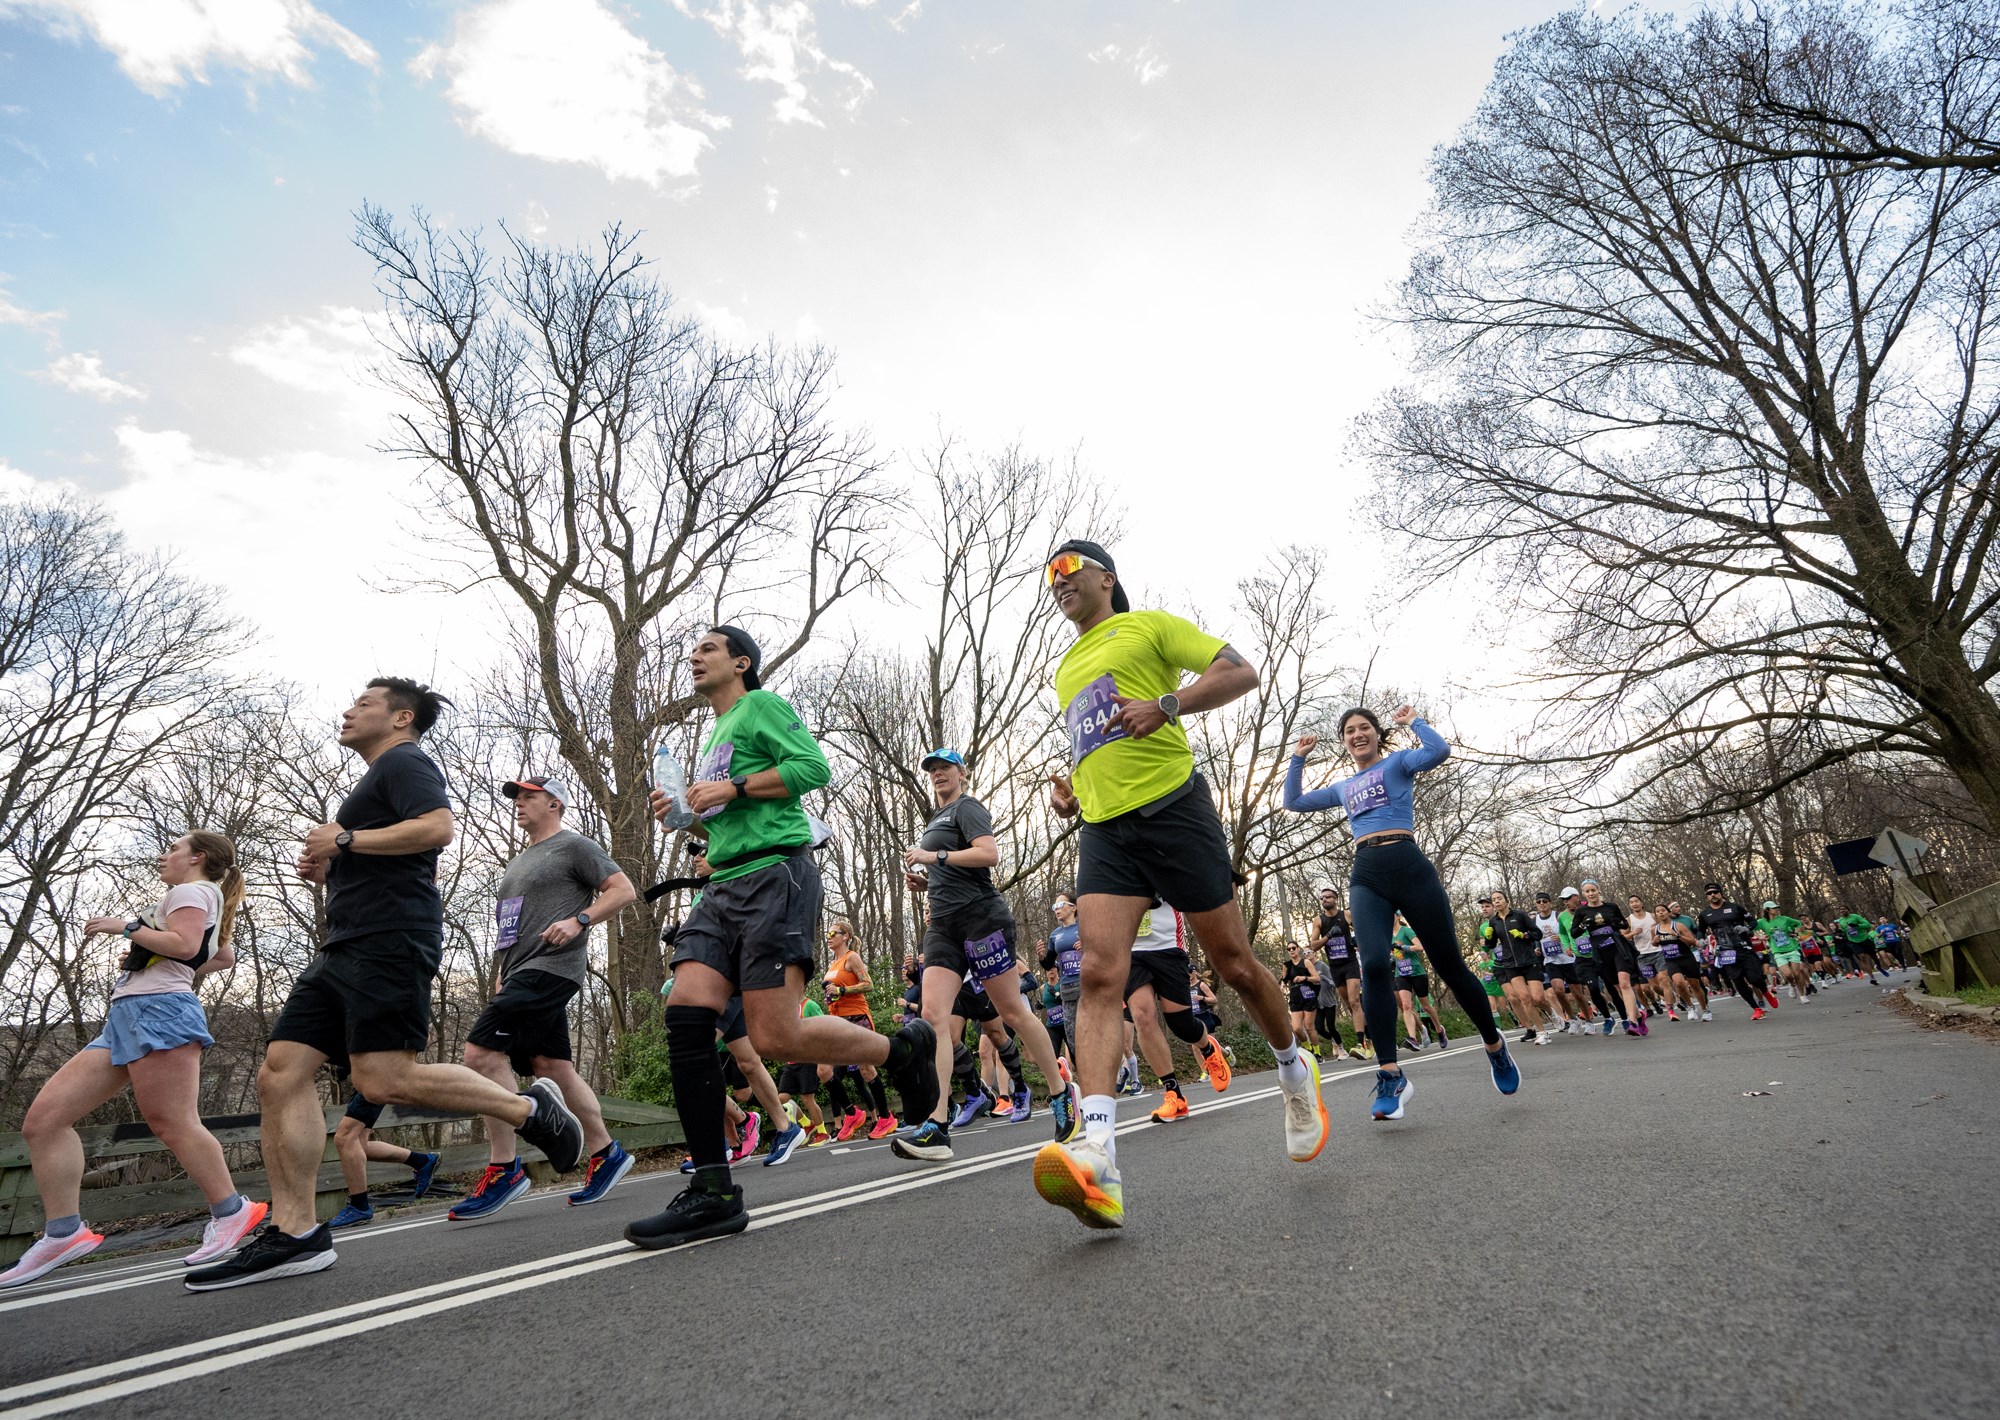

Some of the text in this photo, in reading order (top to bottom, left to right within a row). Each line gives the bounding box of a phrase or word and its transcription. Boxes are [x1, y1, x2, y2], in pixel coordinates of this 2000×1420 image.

[1077, 696, 1089, 708] NYC
[1110, 724, 1122, 733] WAV
[1353, 784, 1385, 804] 11833
[974, 948, 1009, 970] 10834
